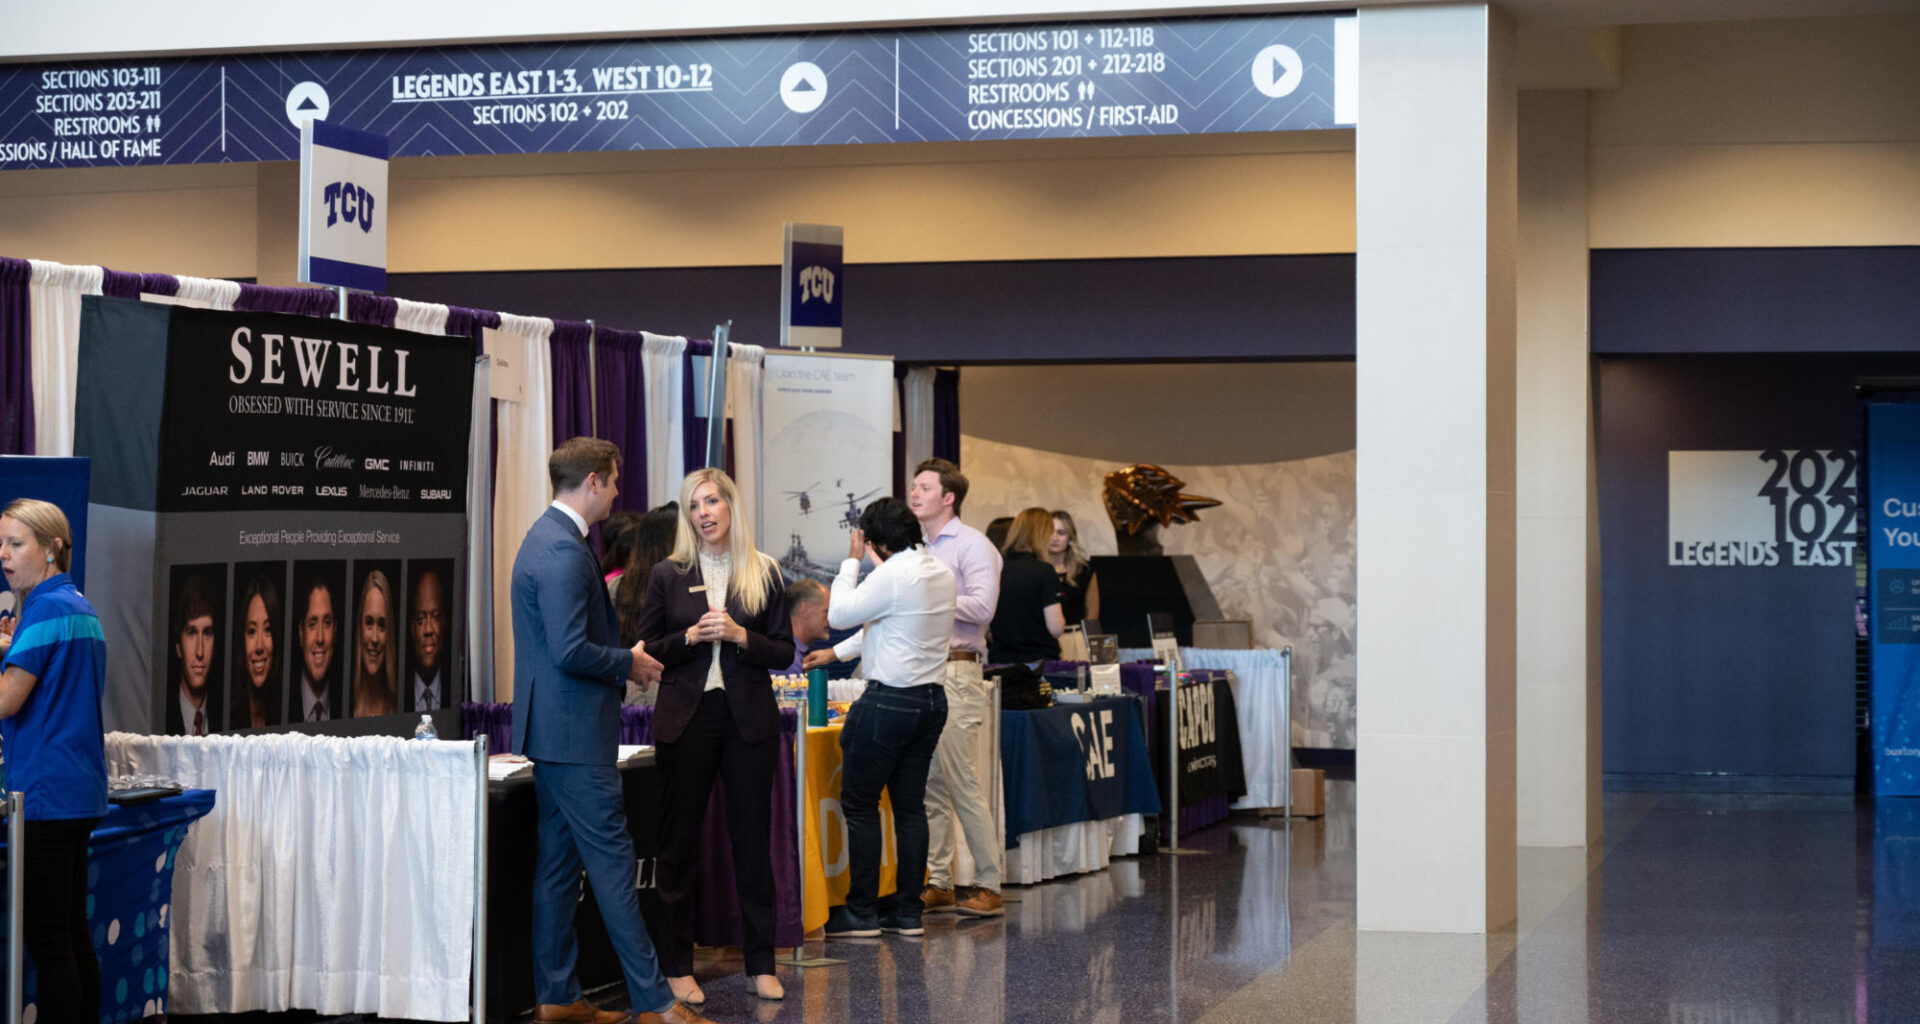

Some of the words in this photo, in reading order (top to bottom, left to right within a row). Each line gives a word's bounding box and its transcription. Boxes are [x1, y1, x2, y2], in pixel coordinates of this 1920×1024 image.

[968, 31, 1047, 53] SECTIONS
[1052, 30, 1078, 50] 101
[1084, 33, 1094, 45] +
[1099, 27, 1154, 48] 112-118
[42, 70, 109, 89] SECTIONS
[113, 67, 161, 86] 103-111
[968, 56, 1047, 78] SECTIONS
[1051, 55, 1082, 76] 201
[1088, 59, 1097, 70] +
[1102, 52, 1165, 74] 212-218
[392, 72, 484, 99] LEGENDS
[490, 70, 542, 95] EAST
[547, 69, 583, 94] 1-3,
[593, 66, 651, 91] WEST
[656, 64, 712, 88] 10-12
[968, 82, 1069, 104] RESTROOMS
[36, 93, 104, 113] SECTIONS
[106, 91, 161, 110] 203-211
[473, 103, 546, 125] SECTIONS
[550, 102, 578, 122] 102
[583, 106, 592, 117] +
[596, 101, 628, 120] 202
[54, 116, 140, 136] RESTROOMS
[968, 107, 1083, 130] CONCESSIONS
[1087, 106, 1096, 129] /
[1100, 104, 1179, 126] FIRST-AID
[50, 141, 57, 163] /
[61, 141, 97, 160] HALL
[101, 140, 120, 158] OF
[124, 139, 161, 157] FAME
[324, 181, 375, 234] TCU
[799, 265, 835, 304] TCU
[229, 326, 417, 397] SEWELL
[228, 395, 282, 414] OBSESSED
[285, 396, 314, 416] WITH
[316, 399, 358, 420] SERVICE
[361, 403, 391, 422] SINCE
[209, 451, 235, 467] Audi
[247, 451, 270, 466] BMW
[280, 452, 305, 467] BUICK
[315, 446, 354, 471] Cadillac
[365, 458, 390, 471] GMC
[400, 459, 434, 472] INFINITI
[1757, 450, 1857, 497] 202
[181, 486, 229, 496] JAGUAR
[241, 485, 268, 495] LAND
[272, 485, 304, 496] ROVER
[315, 486, 348, 497] LEXUS
[359, 484, 410, 500] Mercedes-Benz
[421, 489, 452, 500] SUBARU
[1769, 495, 1857, 542] 102
[1883, 498, 1920, 518] Cu
[239, 530, 279, 546] Exceptional
[281, 530, 304, 546] People
[306, 529, 337, 546] Providing
[337, 530, 375, 546] Exceptional
[376, 530, 400, 544] Service
[1669, 541, 1779, 566] LEGENDS
[1793, 541, 1856, 566] EAST
